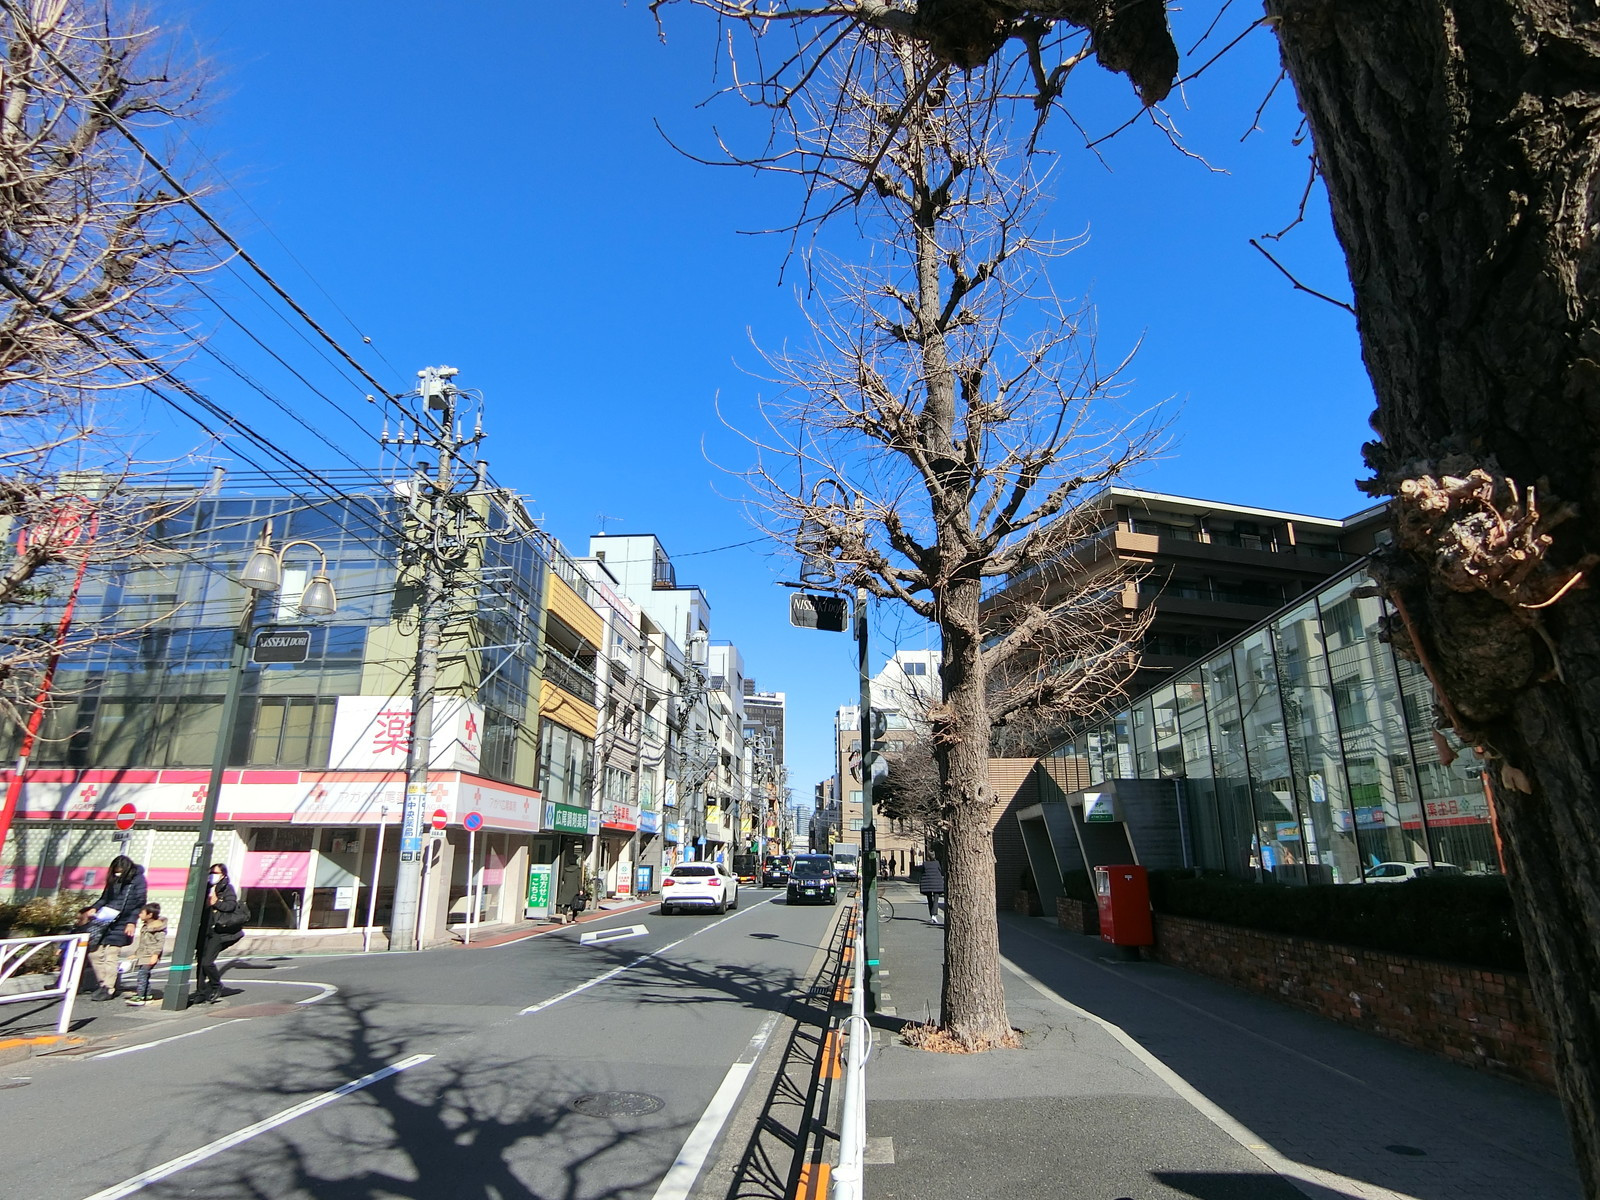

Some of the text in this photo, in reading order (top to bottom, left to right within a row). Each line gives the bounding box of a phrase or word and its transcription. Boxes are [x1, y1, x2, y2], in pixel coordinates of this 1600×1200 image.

[258, 637, 308, 647] NISSEKI DORI
[372, 708, 416, 756] 薬
[530, 878, 539, 902] こちら
